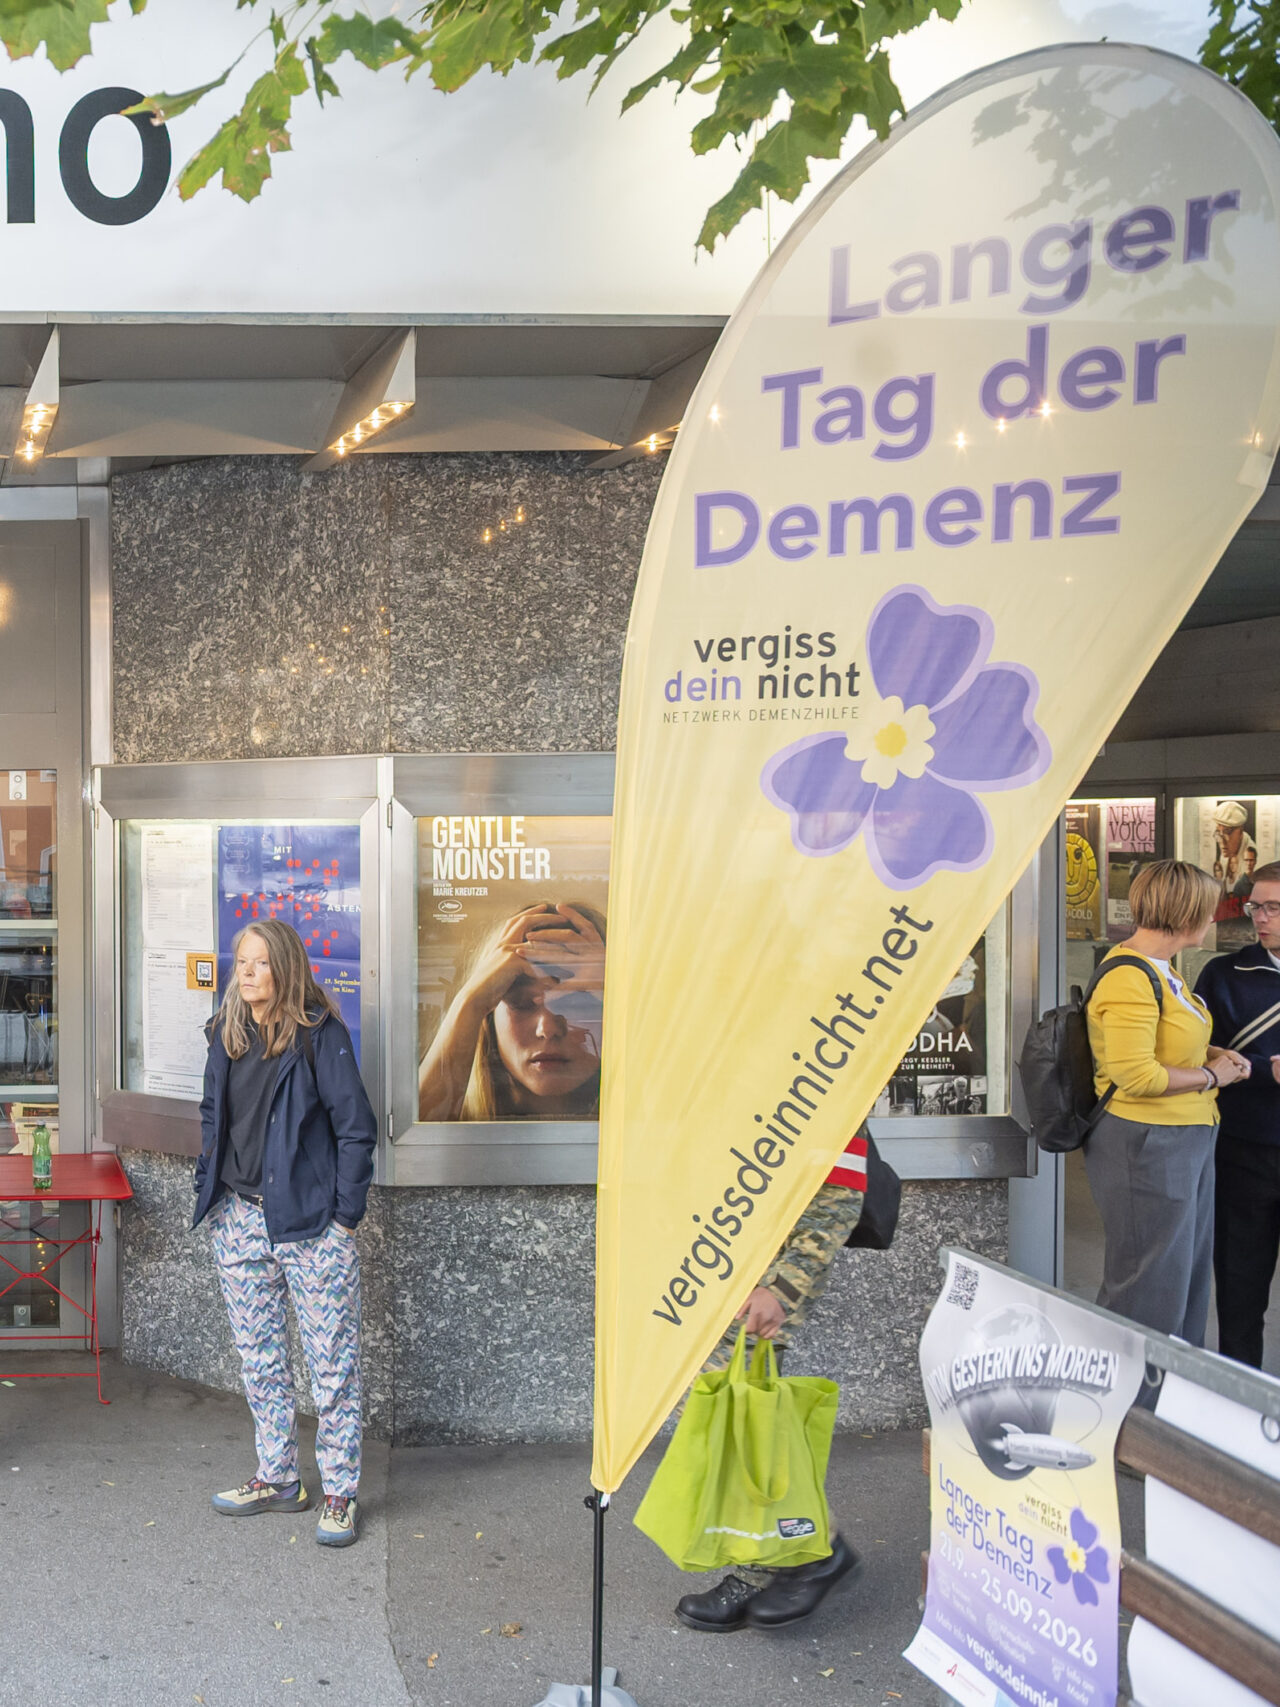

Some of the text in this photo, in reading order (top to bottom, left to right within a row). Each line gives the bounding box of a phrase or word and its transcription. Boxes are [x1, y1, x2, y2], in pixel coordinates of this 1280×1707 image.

[827, 189, 1241, 327] Langer
[761, 322, 1186, 462] Tag der
[694, 471, 1122, 569] Demenz
[693, 625, 837, 668] vergiss
[664, 662, 860, 702] dein nicht
[663, 706, 860, 723] NETZWERK DEMENZHILFE
[432, 816, 525, 848] GENTLE
[1109, 806, 1145, 824] NEW
[274, 846, 292, 854] MIT
[432, 848, 551, 880] MONSTER
[433, 887, 488, 896] MARIE KREUTZER
[652, 904, 934, 1327] vergissdeinnicht.net
[951, 1346, 1014, 1393] GESTERN
[1013, 1343, 1047, 1378] INS
[1044, 1344, 1120, 1388] MORGEN
[939, 1463, 1034, 1565] Langer Tag
[1018, 1502, 1068, 1537] dein nicht
[1024, 1492, 1063, 1520] vergiss
[946, 1500, 1054, 1600] der Demenz
[980, 1567, 1098, 1668] 25.09.2026
